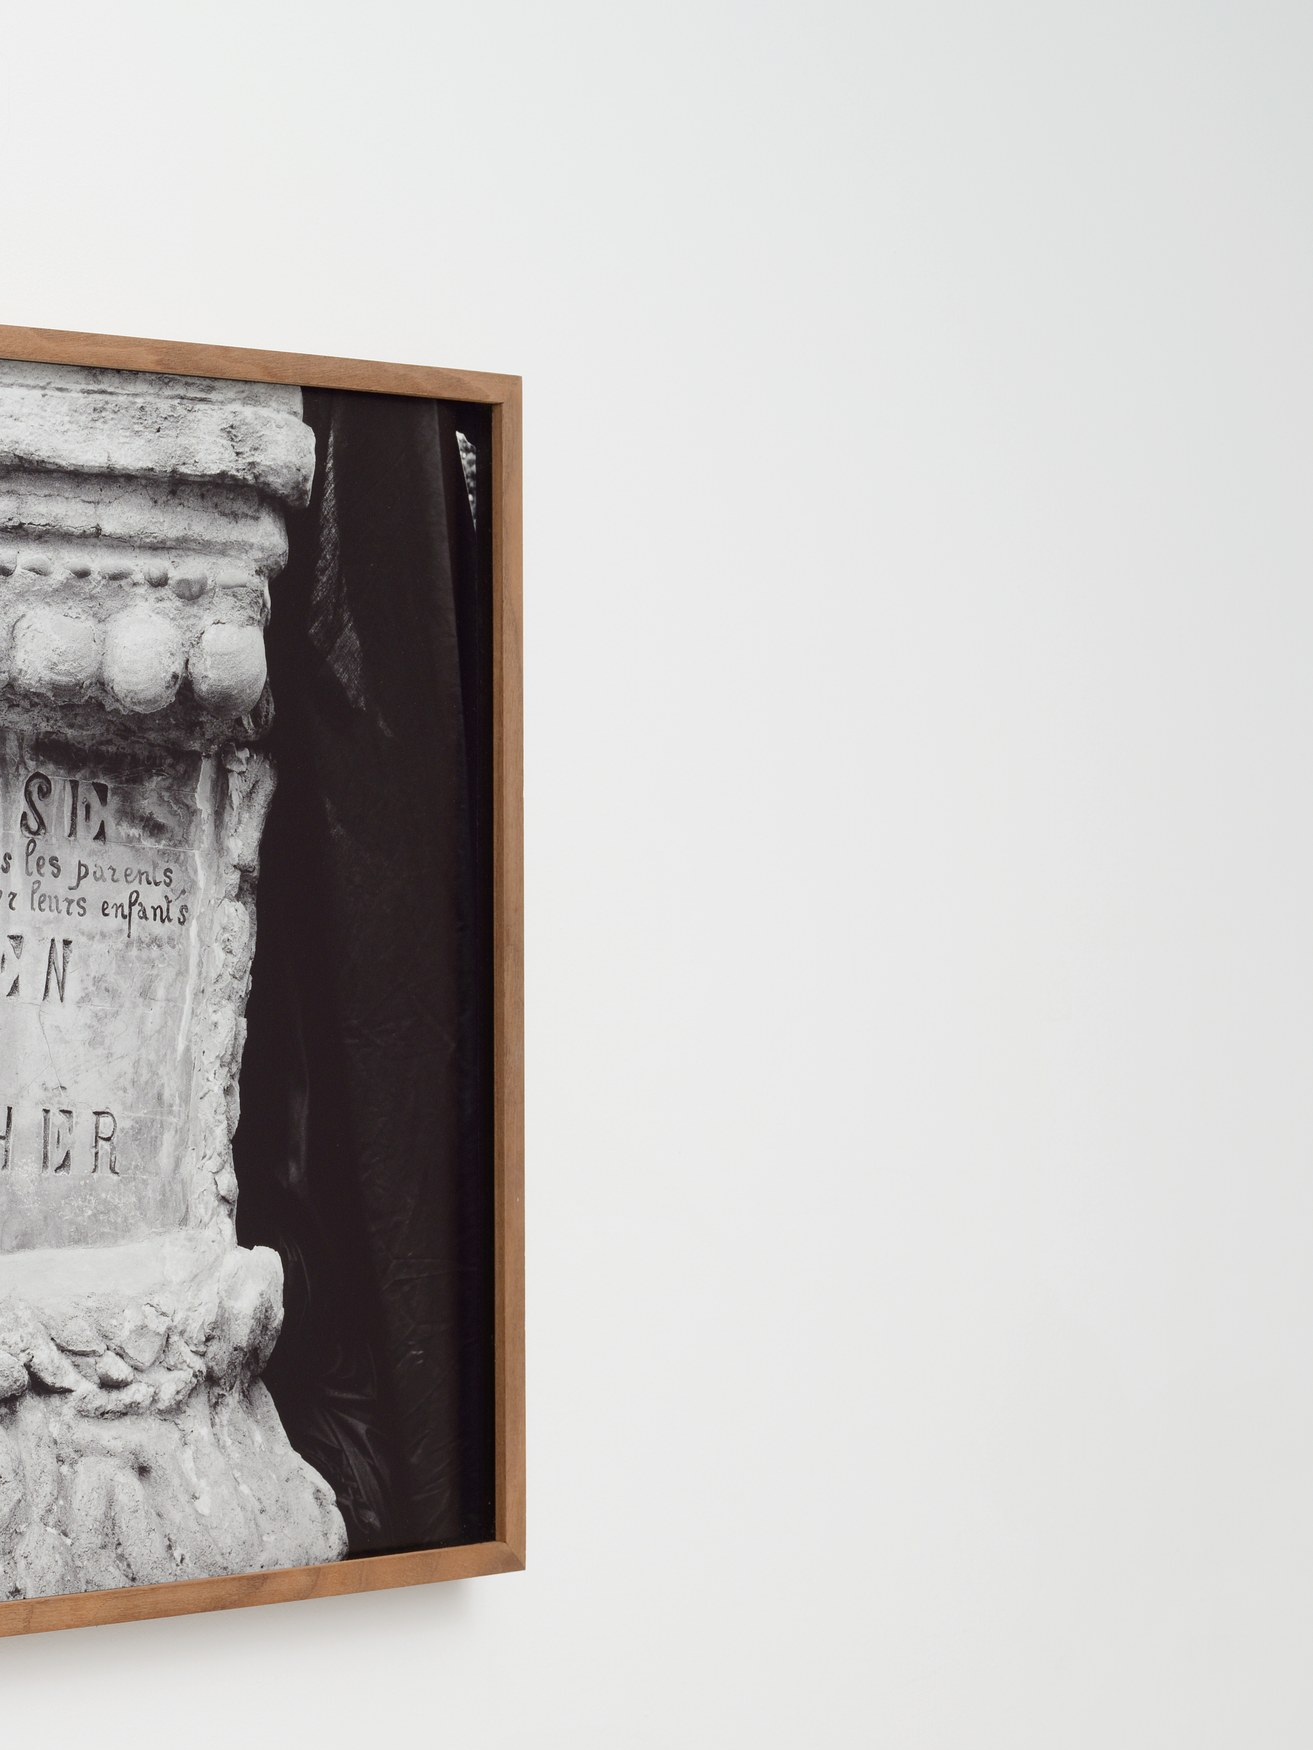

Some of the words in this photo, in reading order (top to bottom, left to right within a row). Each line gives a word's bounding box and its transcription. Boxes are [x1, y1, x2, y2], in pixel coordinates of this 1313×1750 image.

[25, 838, 62, 878] les
[68, 860, 173, 890] parents
[31, 880, 86, 917] leurs
